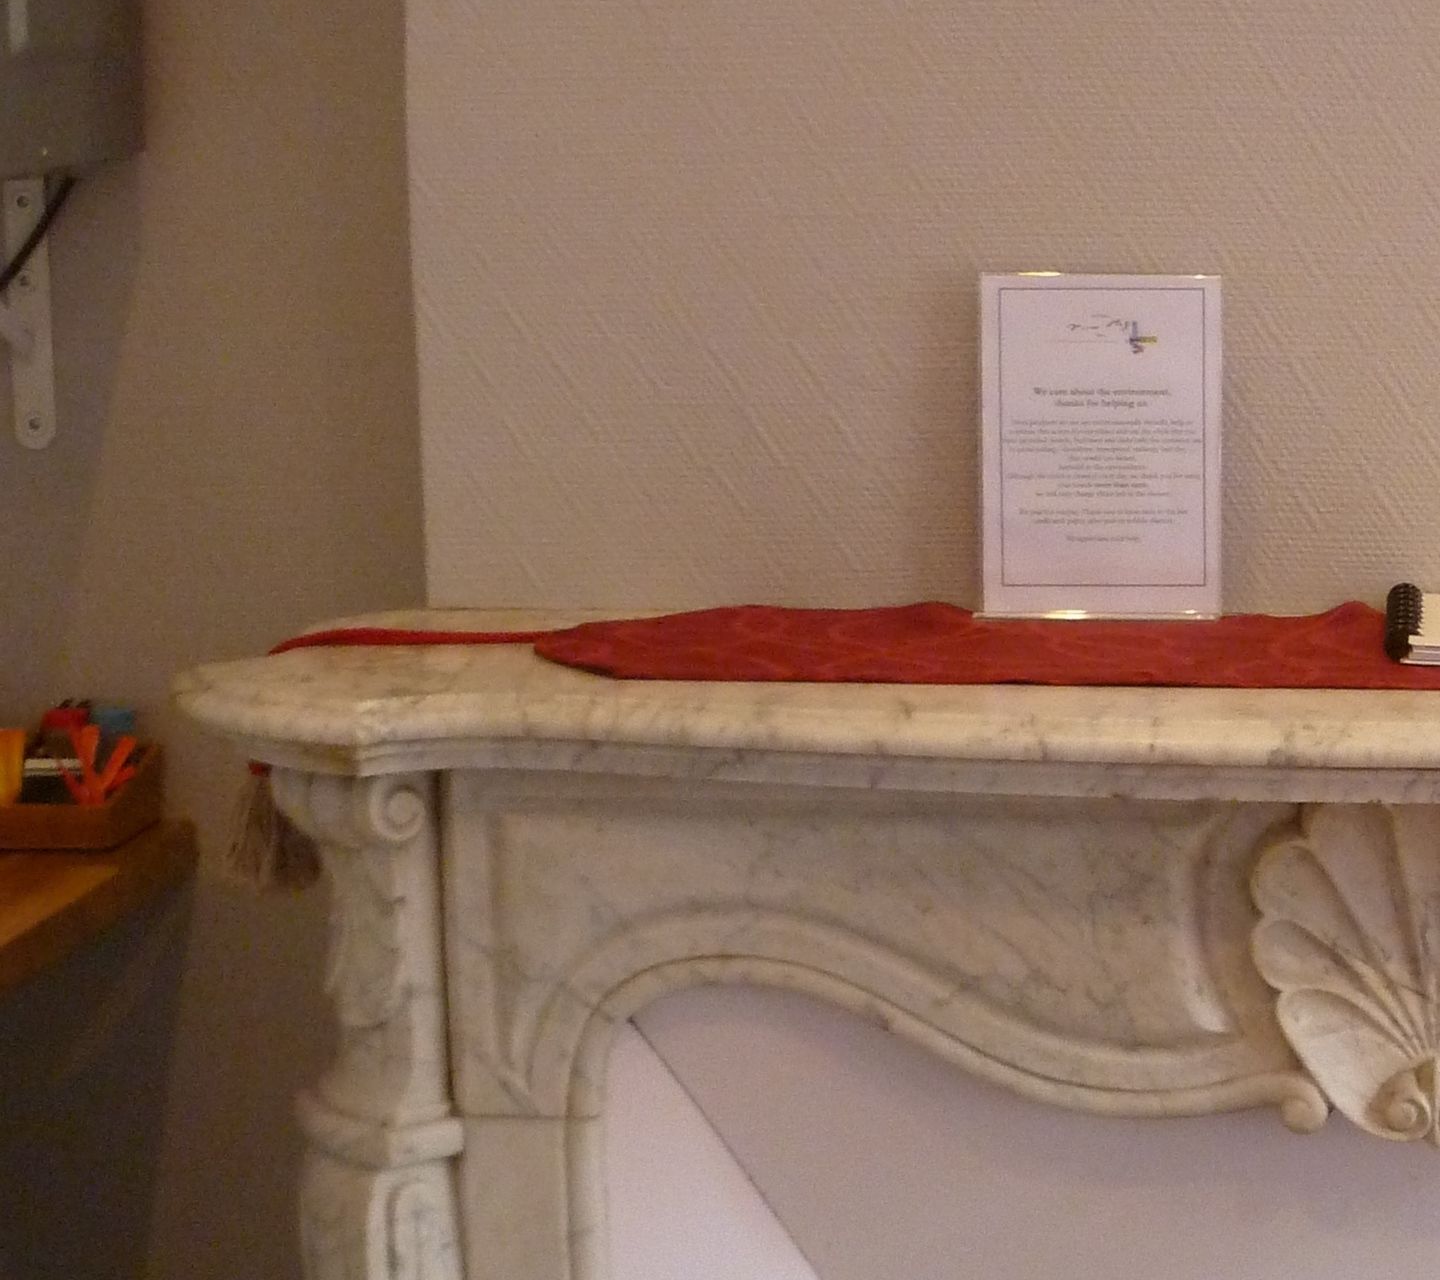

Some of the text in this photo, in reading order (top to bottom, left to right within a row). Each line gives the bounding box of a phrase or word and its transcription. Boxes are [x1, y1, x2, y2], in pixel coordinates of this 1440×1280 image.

[1070, 387, 1095, 396] about
[1096, 387, 1110, 396] the
[1086, 399, 1099, 407] for
[1101, 398, 1134, 409] helping
